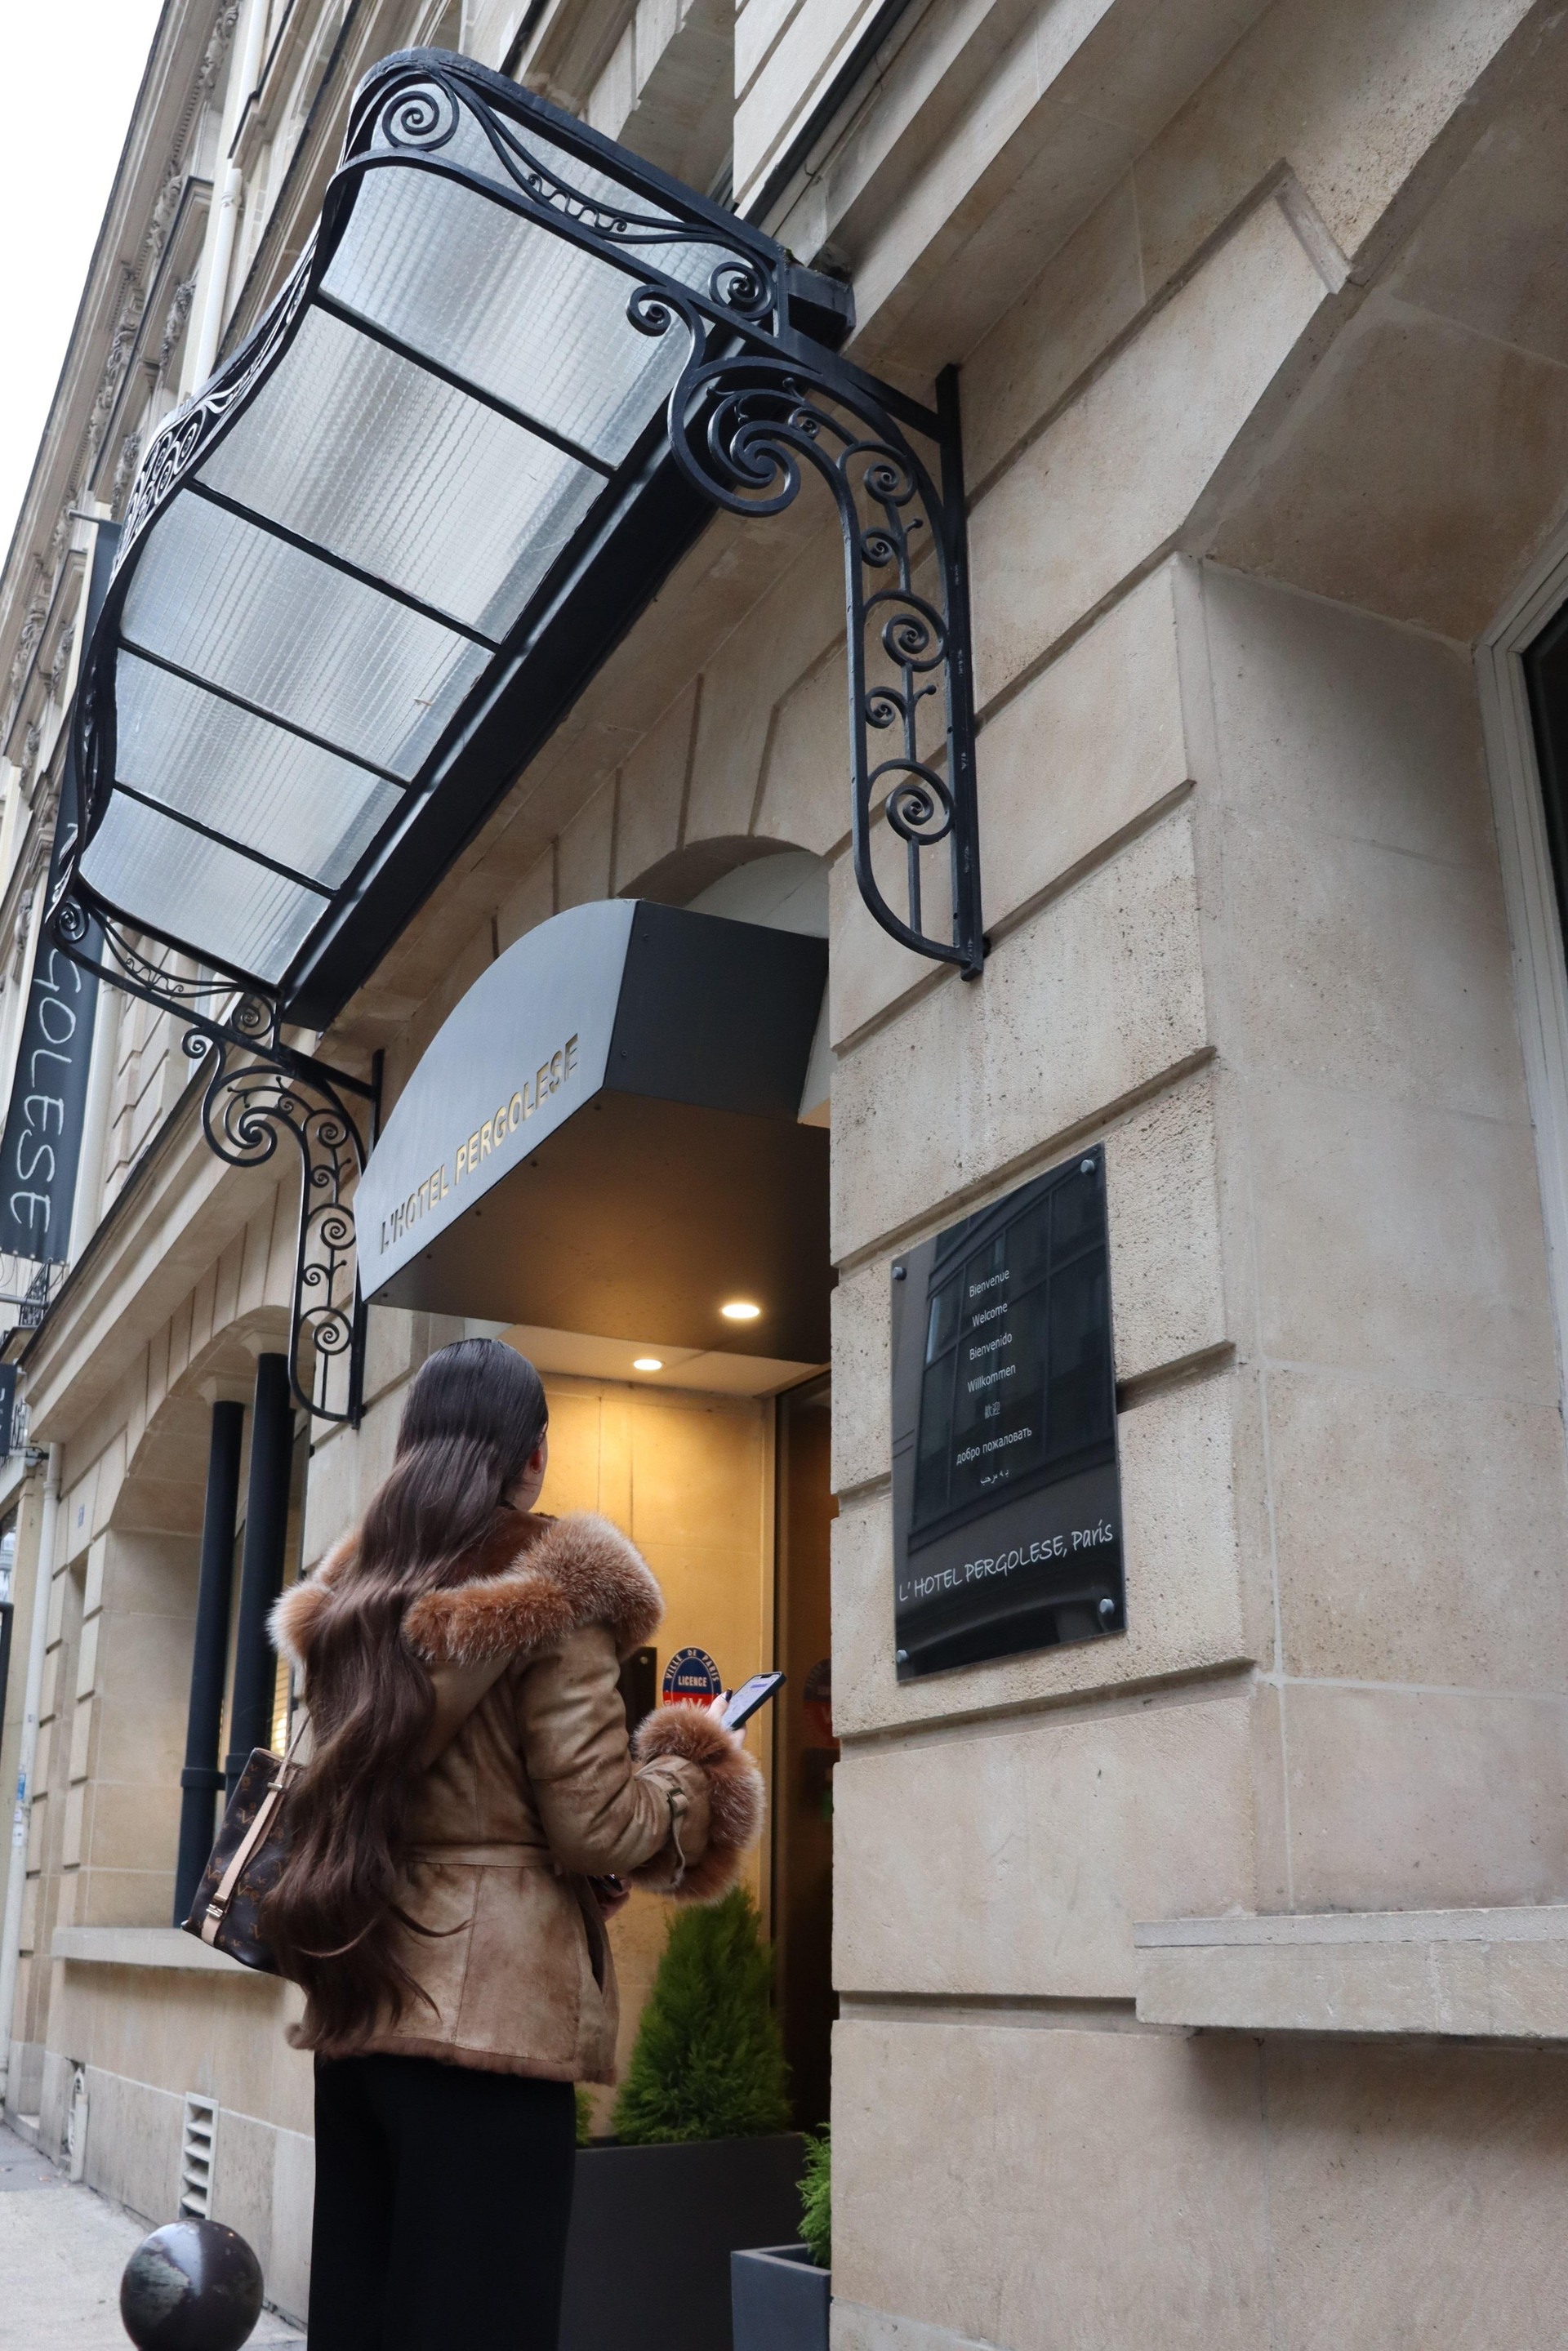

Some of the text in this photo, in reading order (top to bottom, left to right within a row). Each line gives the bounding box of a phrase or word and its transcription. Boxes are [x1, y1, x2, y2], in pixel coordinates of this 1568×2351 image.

[381, 1032, 578, 1255] L'HOTEL PERGOLESE
[969, 1270, 1010, 1298] Bienvenue
[972, 1302, 1008, 1327] Welcome
[969, 1332, 1013, 1360] Bienvenido
[967, 1365, 1016, 1393] Willkommen
[956, 1427, 1032, 1466] добро пожаловать
[899, 1567, 963, 1601] L'HOTEL
[964, 1535, 1067, 1583] PERGOLESE,
[666, 1654, 683, 1679] VILLE
[702, 1654, 720, 1681] PARIS
[678, 1676, 707, 1687] LICENCE
